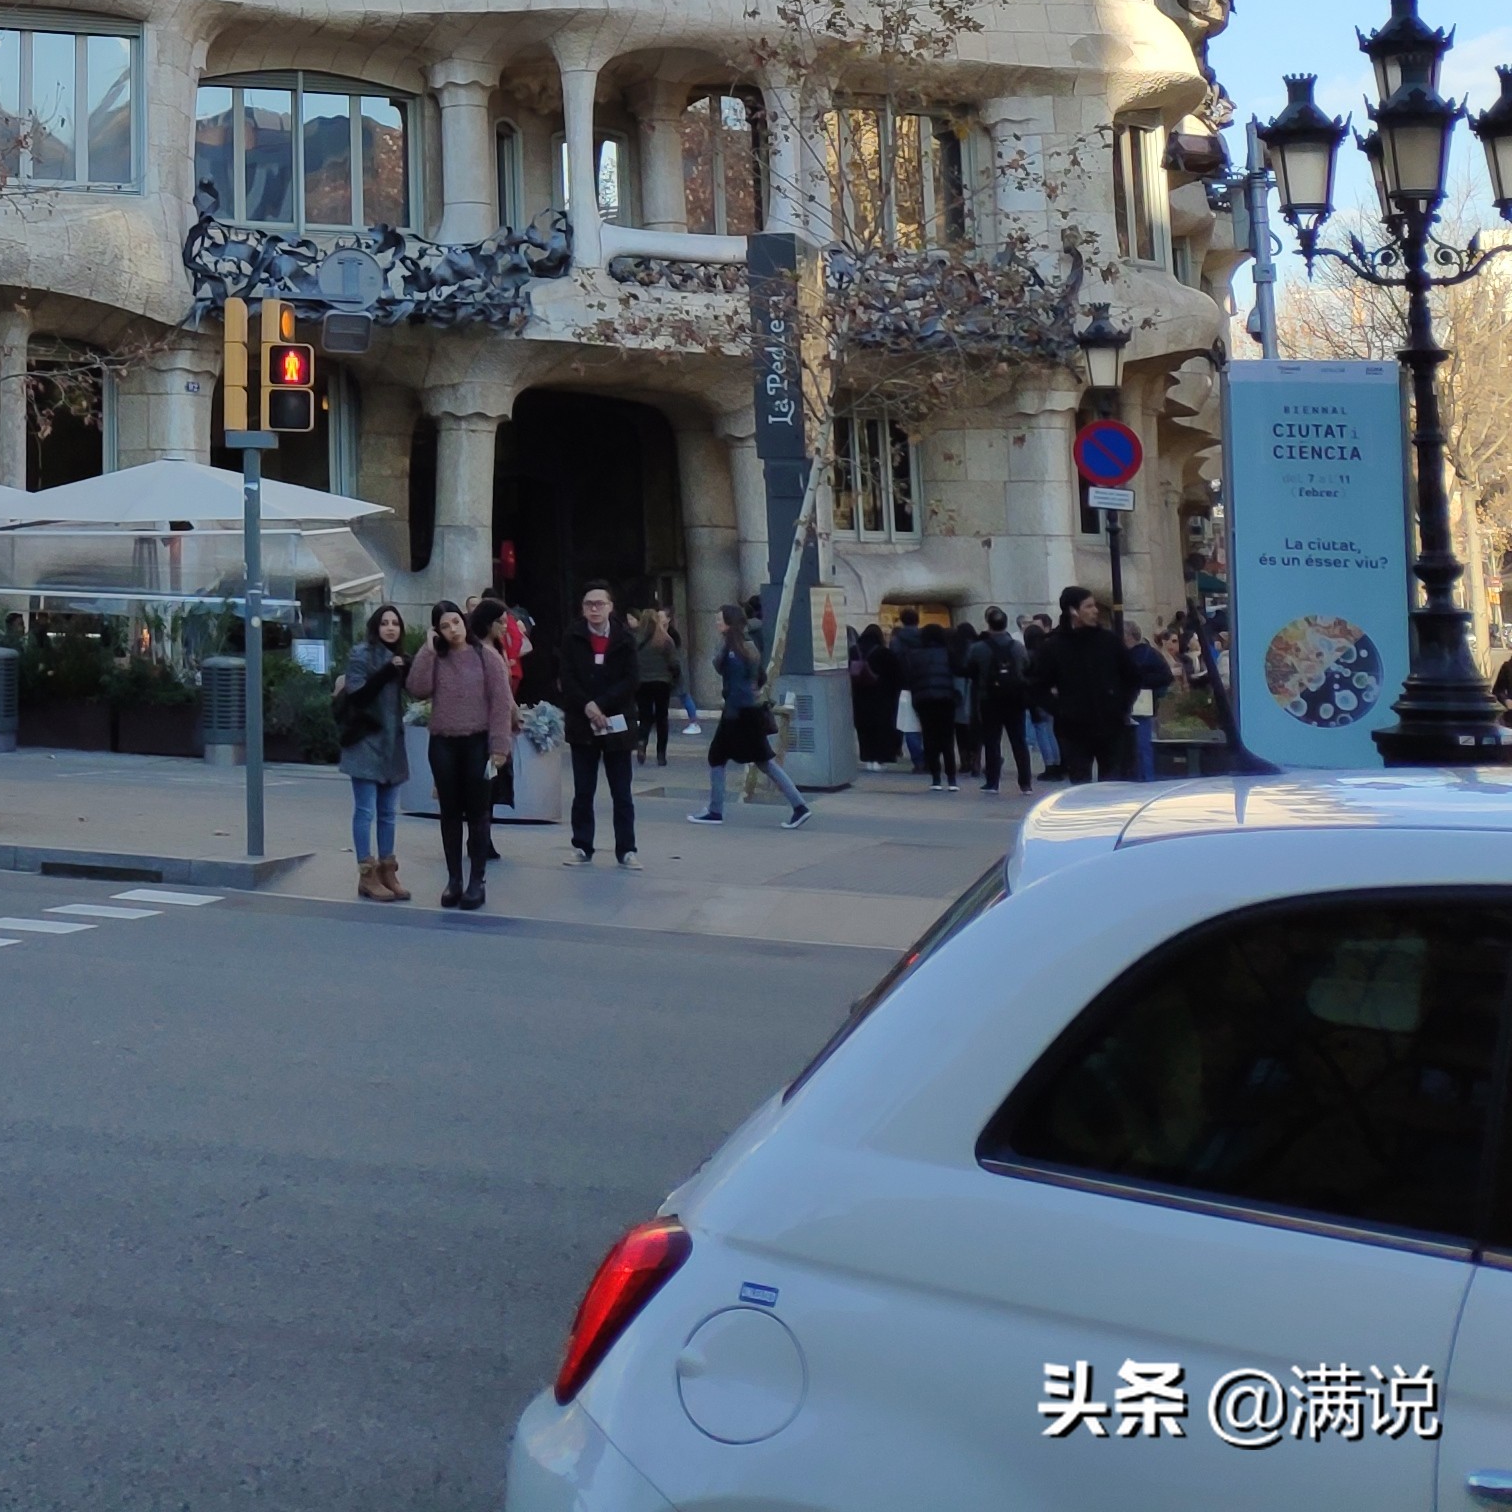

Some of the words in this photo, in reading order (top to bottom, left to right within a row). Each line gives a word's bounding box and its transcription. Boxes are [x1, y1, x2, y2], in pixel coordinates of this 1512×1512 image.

[767, 398, 795, 426] La
[1283, 405, 1348, 416] BIENNAL
[1272, 422, 1348, 439] CIUTAT
[1284, 537, 1304, 551] La
[1307, 537, 1362, 555] ciutat,
[1258, 553, 1277, 566] és
[1281, 556, 1301, 567] un
[1354, 555, 1389, 569] viu?
